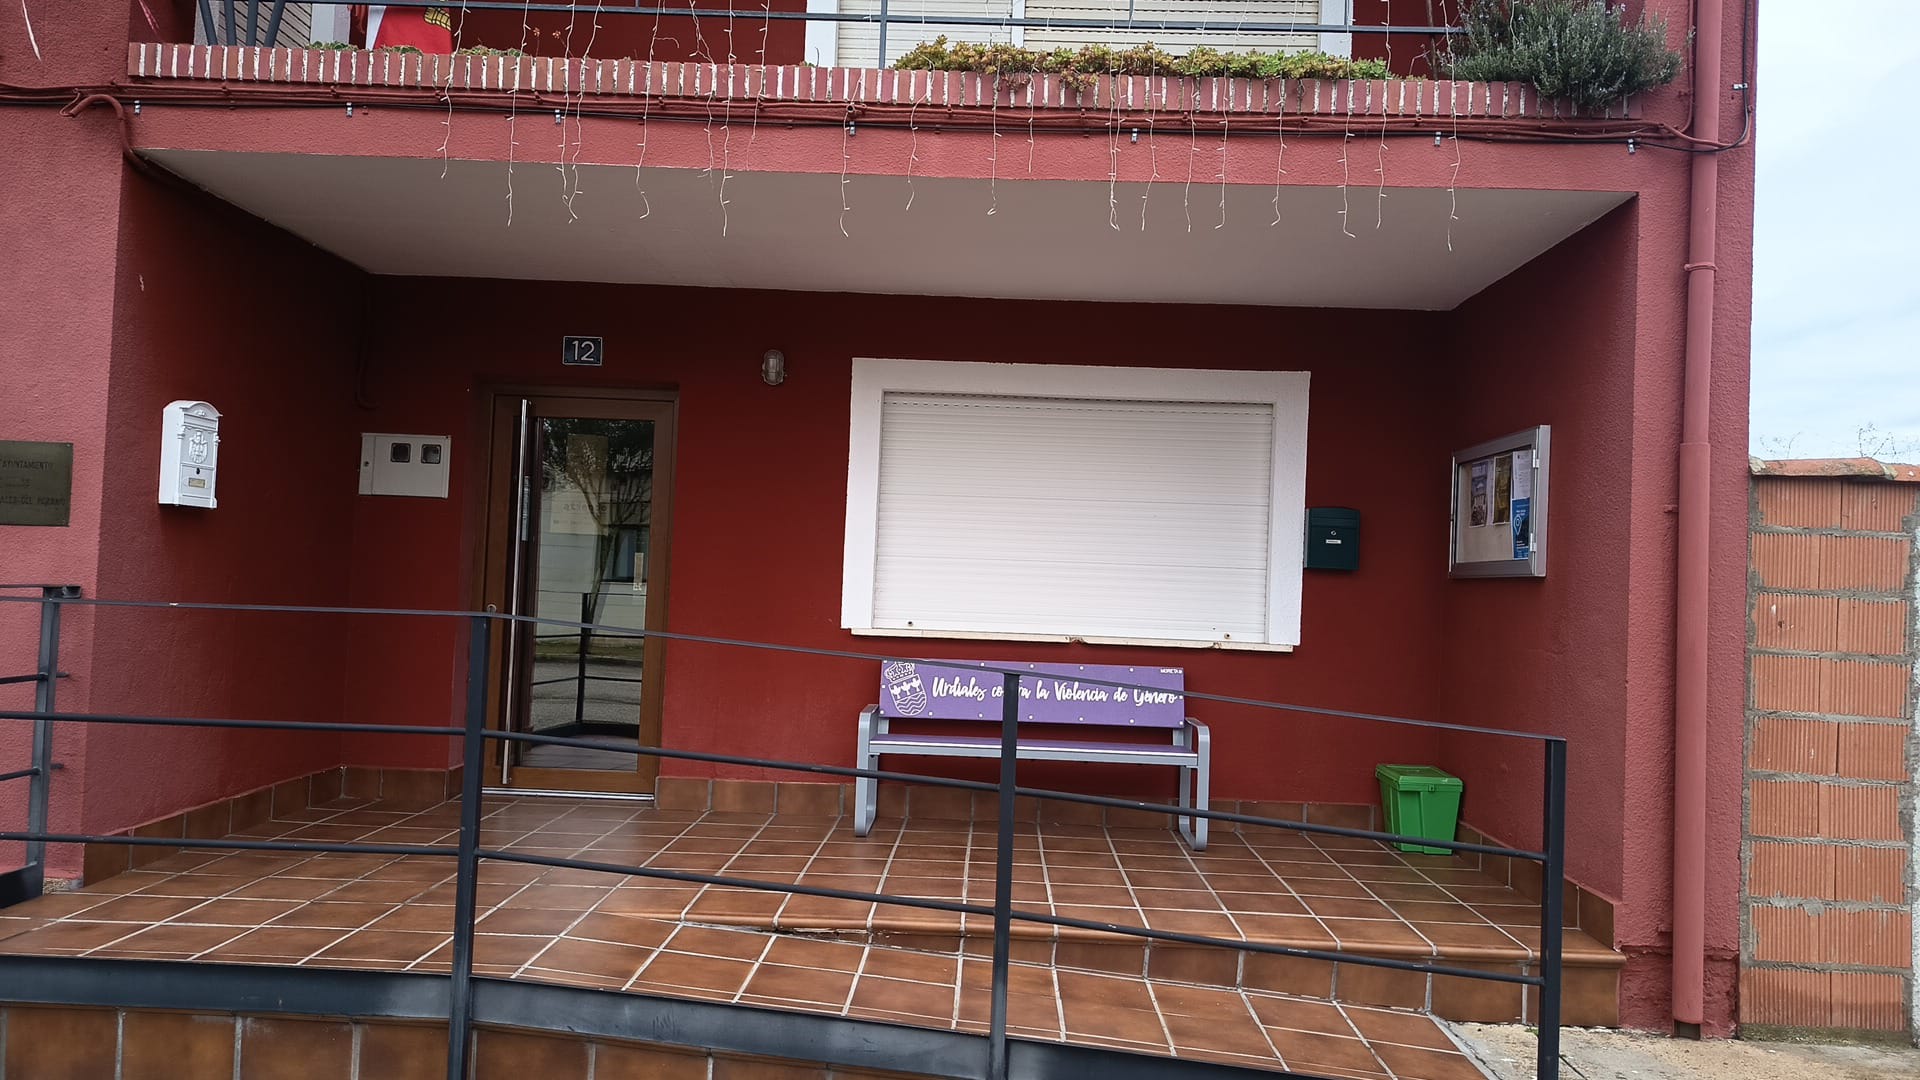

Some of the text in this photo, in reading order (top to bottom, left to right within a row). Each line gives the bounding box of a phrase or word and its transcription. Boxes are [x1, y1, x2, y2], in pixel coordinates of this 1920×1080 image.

[572, 340, 595, 361] 12
[932, 676, 987, 701] Urdiales
[991, 680, 1032, 699] cora
[1036, 680, 1050, 699] la
[1054, 681, 1109, 702] Violencia
[1113, 687, 1128, 702] de
